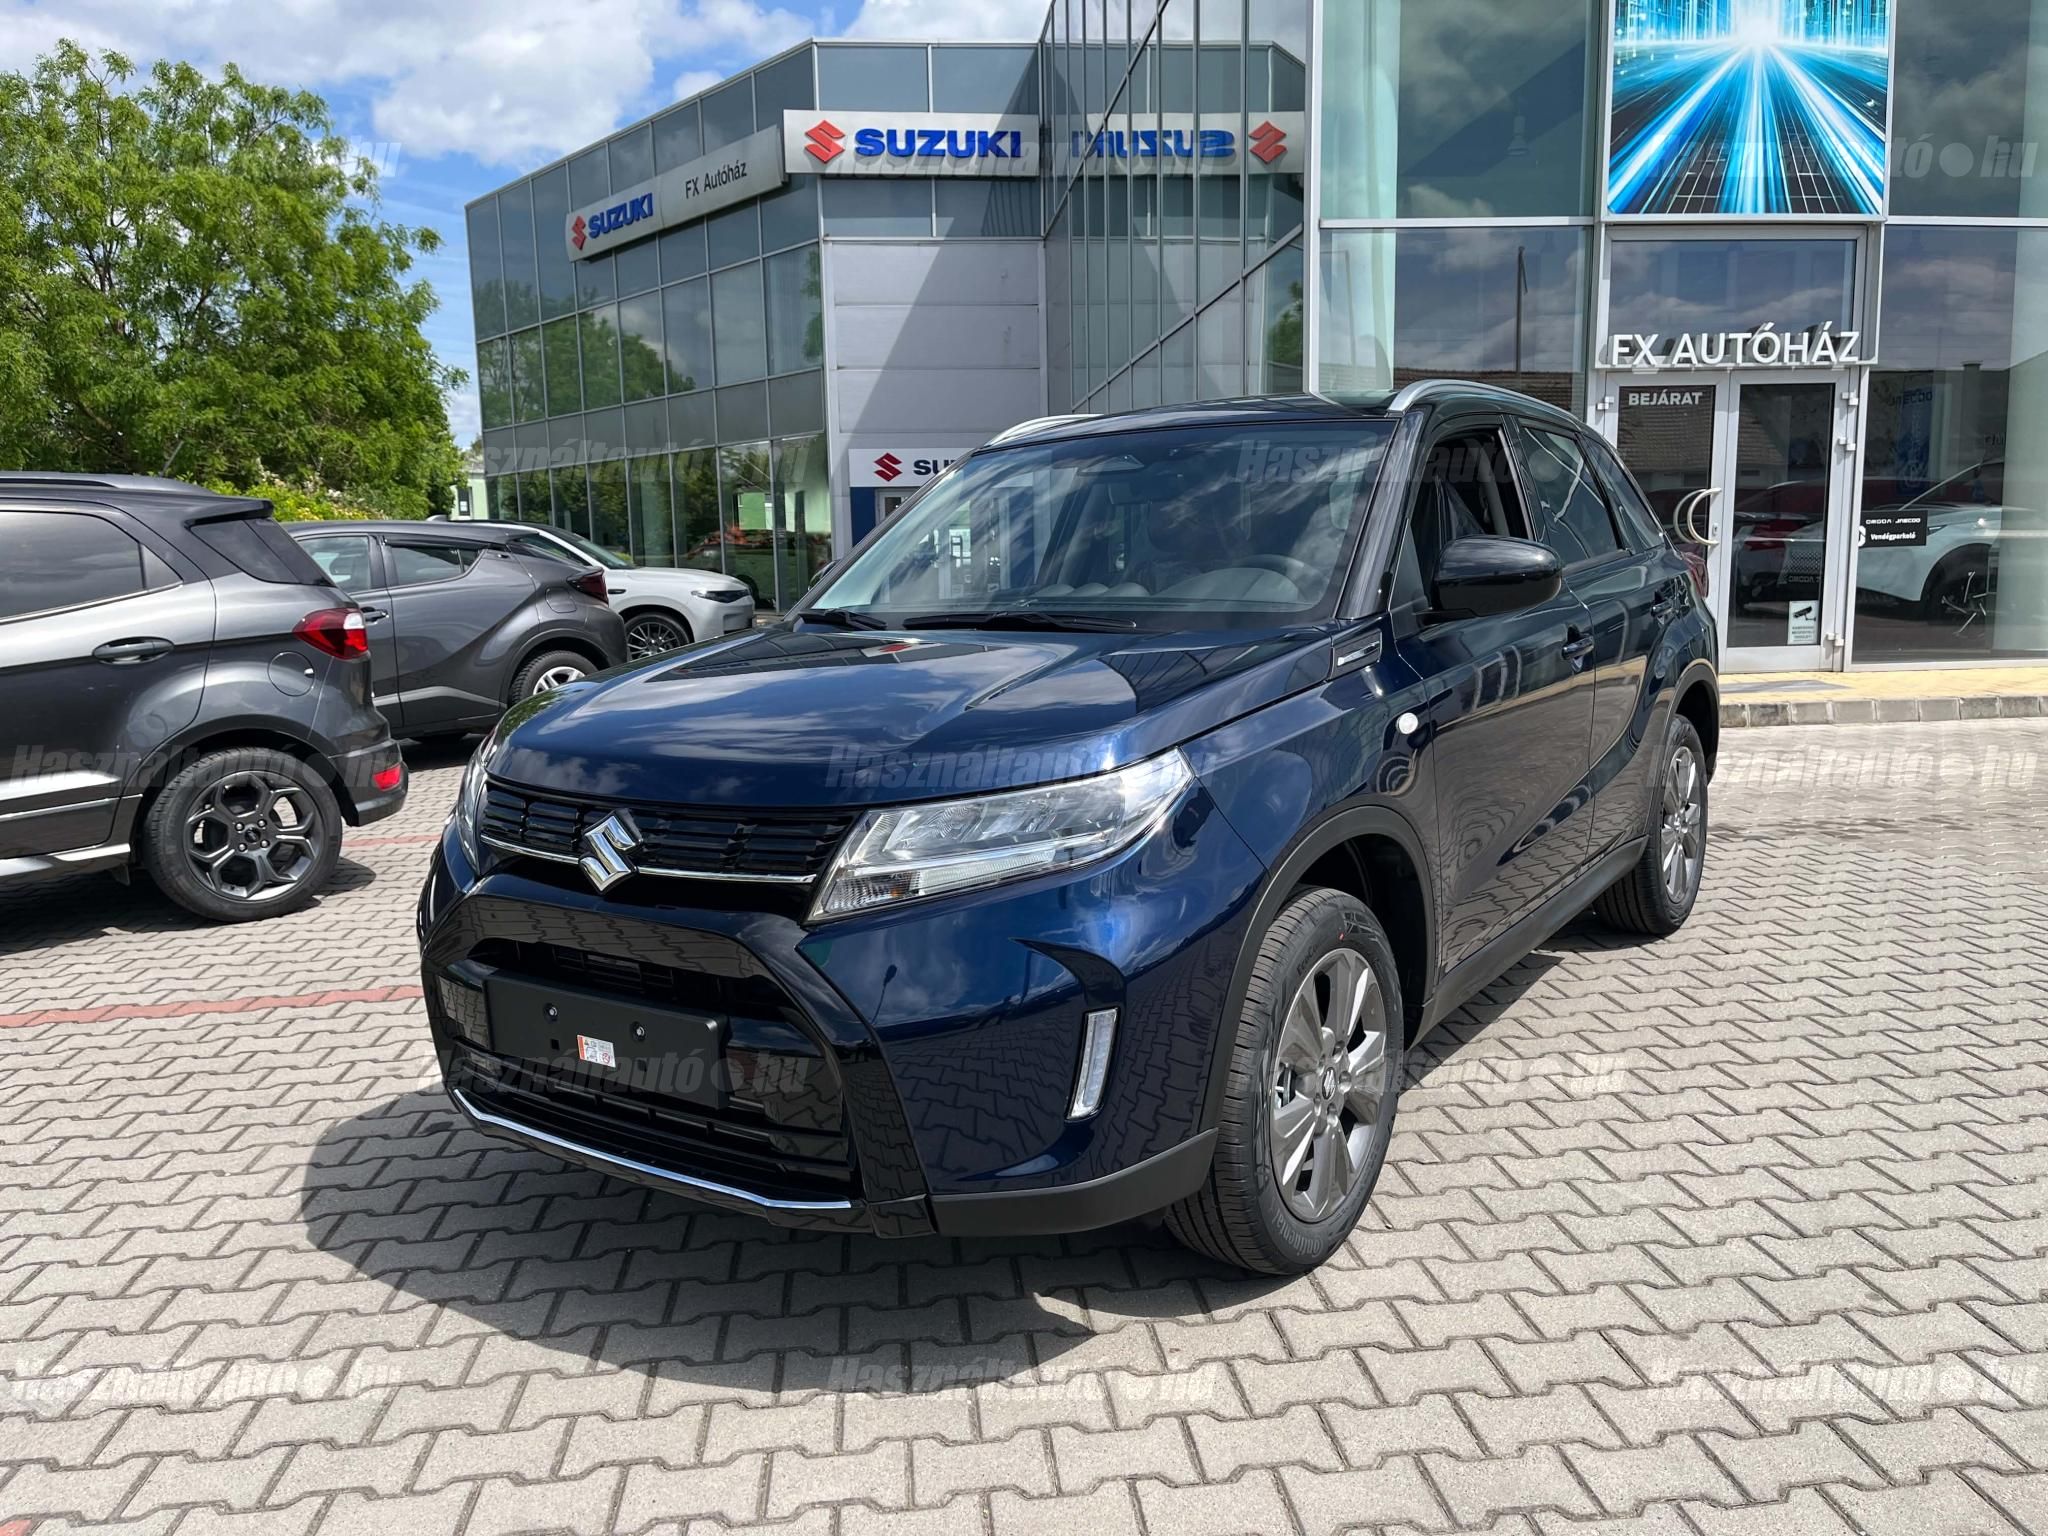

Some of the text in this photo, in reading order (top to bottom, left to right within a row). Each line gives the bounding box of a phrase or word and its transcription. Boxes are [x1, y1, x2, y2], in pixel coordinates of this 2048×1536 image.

[855, 128, 1022, 159] SUZUKI
[685, 160, 748, 199] FX Autóház
[588, 192, 654, 239] SUZUKI
[1612, 320, 1860, 366] FX AUTÓHÁZ
[1628, 388, 1703, 406] BEJÁRAT
[1271, 1207, 1324, 1258] Continental
